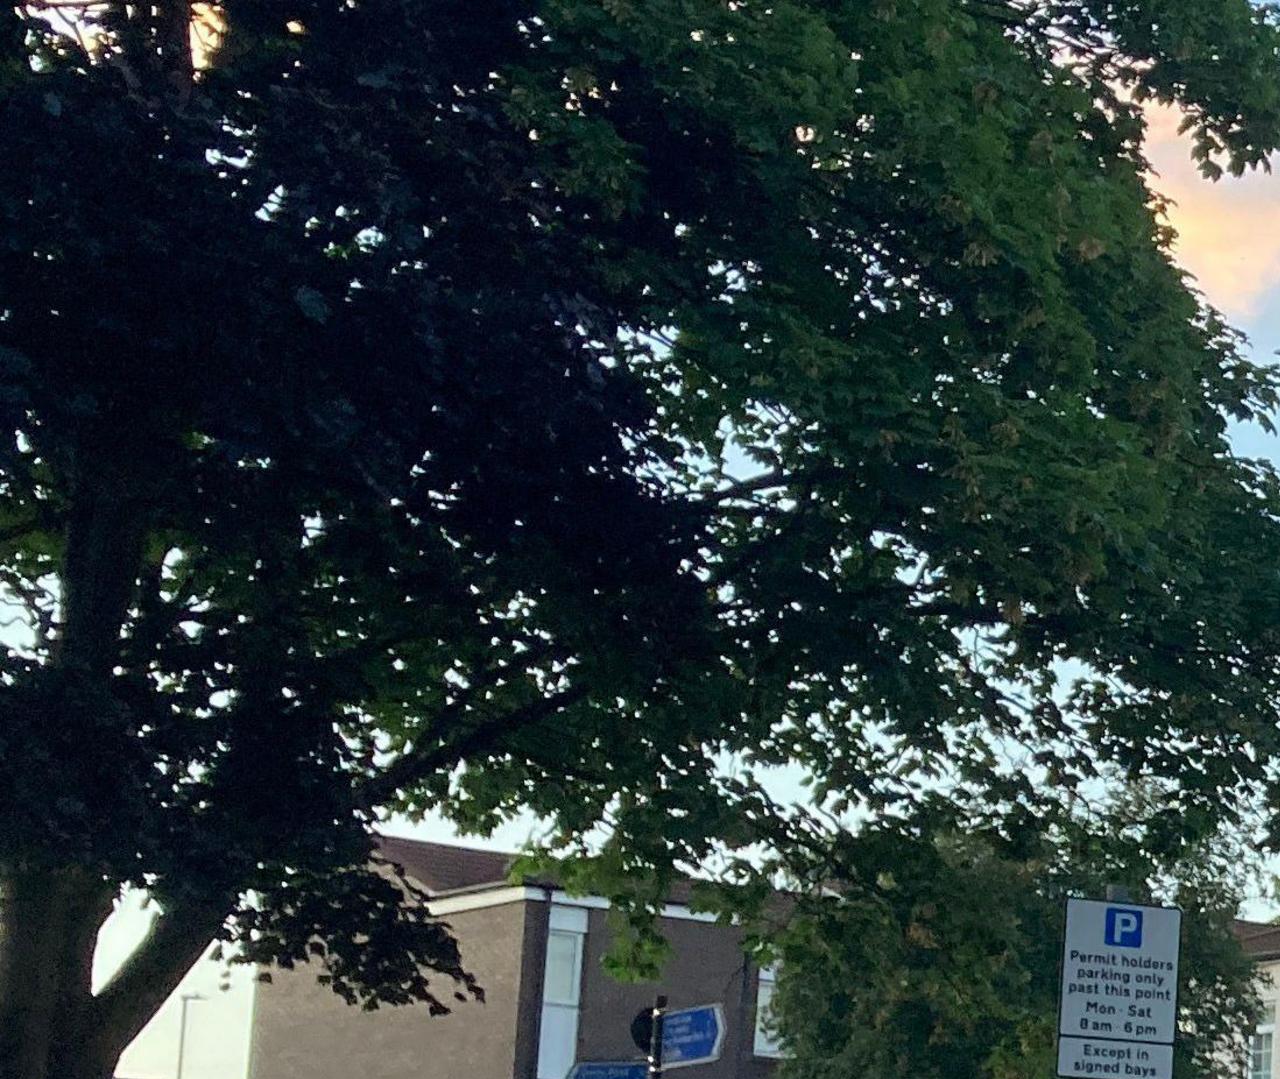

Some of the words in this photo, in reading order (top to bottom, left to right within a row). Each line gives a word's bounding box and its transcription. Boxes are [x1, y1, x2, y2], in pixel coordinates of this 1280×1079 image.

[1113, 912, 1138, 943] P
[1070, 950, 1117, 966] Permit
[1121, 955, 1174, 971] holders
[1077, 967, 1130, 983] parking
[1136, 972, 1164, 987] only
[1068, 981, 1099, 995] past
[1105, 984, 1130, 997] this
[1135, 987, 1172, 1001] point
[1085, 1001, 1116, 1016] Mon
[1127, 1004, 1152, 1019] Sat
[1083, 1044, 1132, 1060] Except
[1137, 1047, 1149, 1061] in
[1073, 1059, 1120, 1074] signed
[1125, 1062, 1157, 1078] bays
